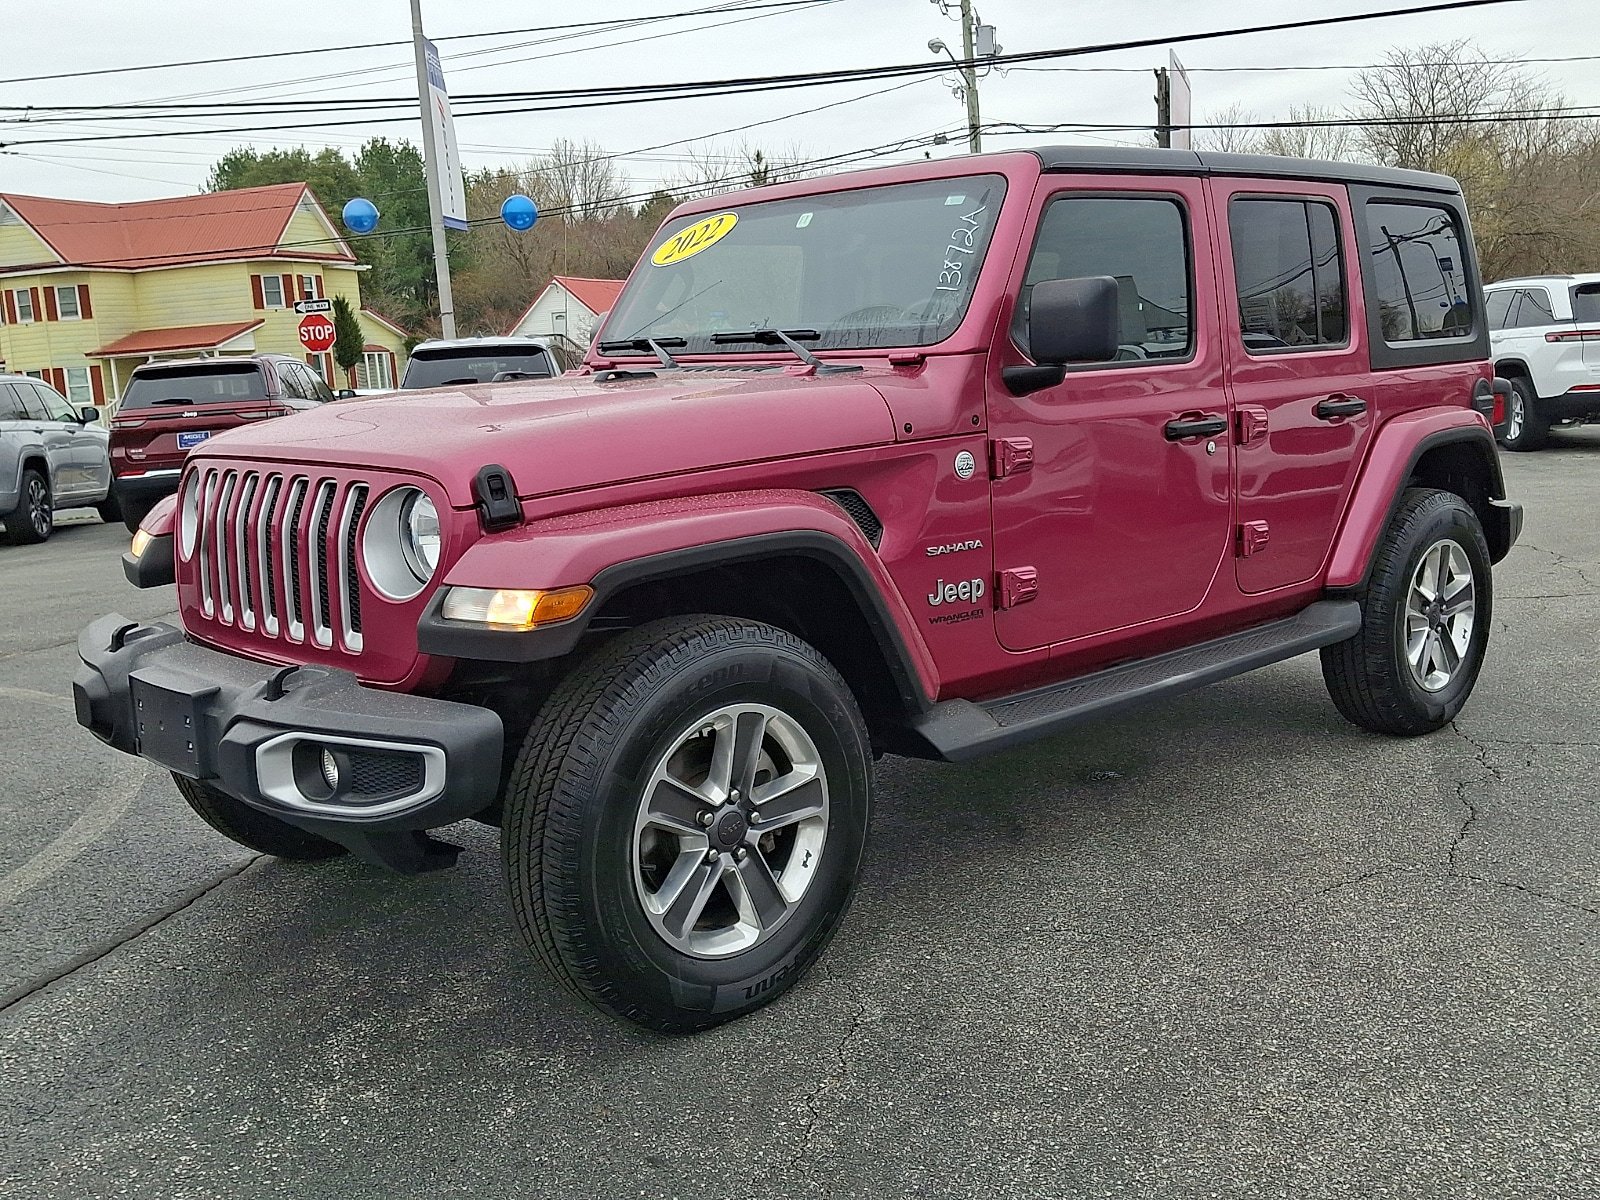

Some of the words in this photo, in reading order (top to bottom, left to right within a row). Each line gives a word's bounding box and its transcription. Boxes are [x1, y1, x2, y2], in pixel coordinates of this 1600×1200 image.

[662, 217, 725, 262] 2022
[935, 205, 986, 291] 13872A
[300, 324, 333, 341] STOP
[926, 539, 984, 556] SAHARA
[928, 577, 985, 606] Jeep
[928, 608, 984, 625] WRANGLER
